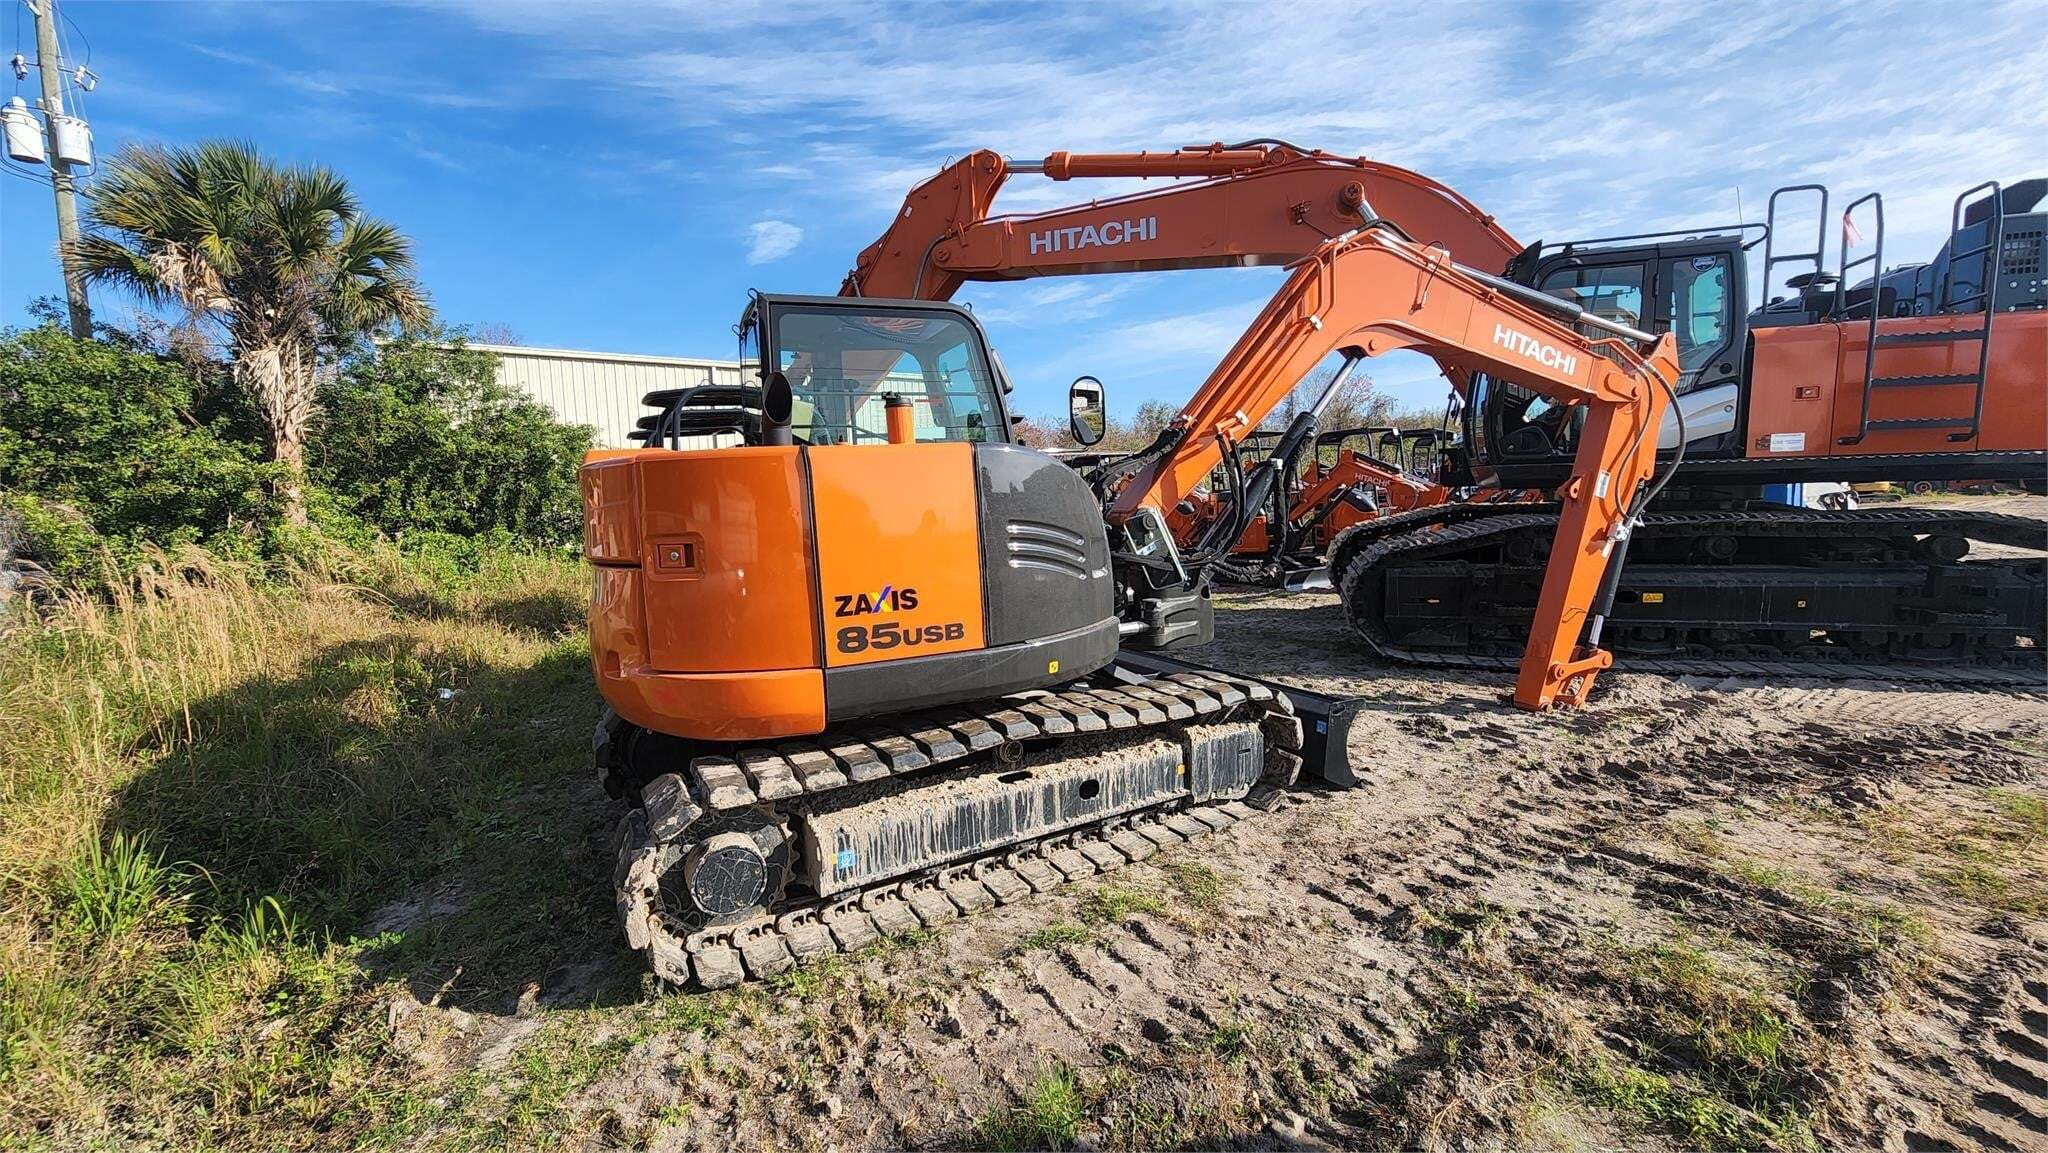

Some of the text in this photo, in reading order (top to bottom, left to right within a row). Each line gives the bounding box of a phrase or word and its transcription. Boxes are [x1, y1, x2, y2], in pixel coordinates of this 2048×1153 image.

[1030, 216, 1157, 255] HITACHI
[1493, 323, 1577, 376] HITACHI
[835, 586, 918, 617] ZAXIS
[837, 622, 965, 653] 85USB
